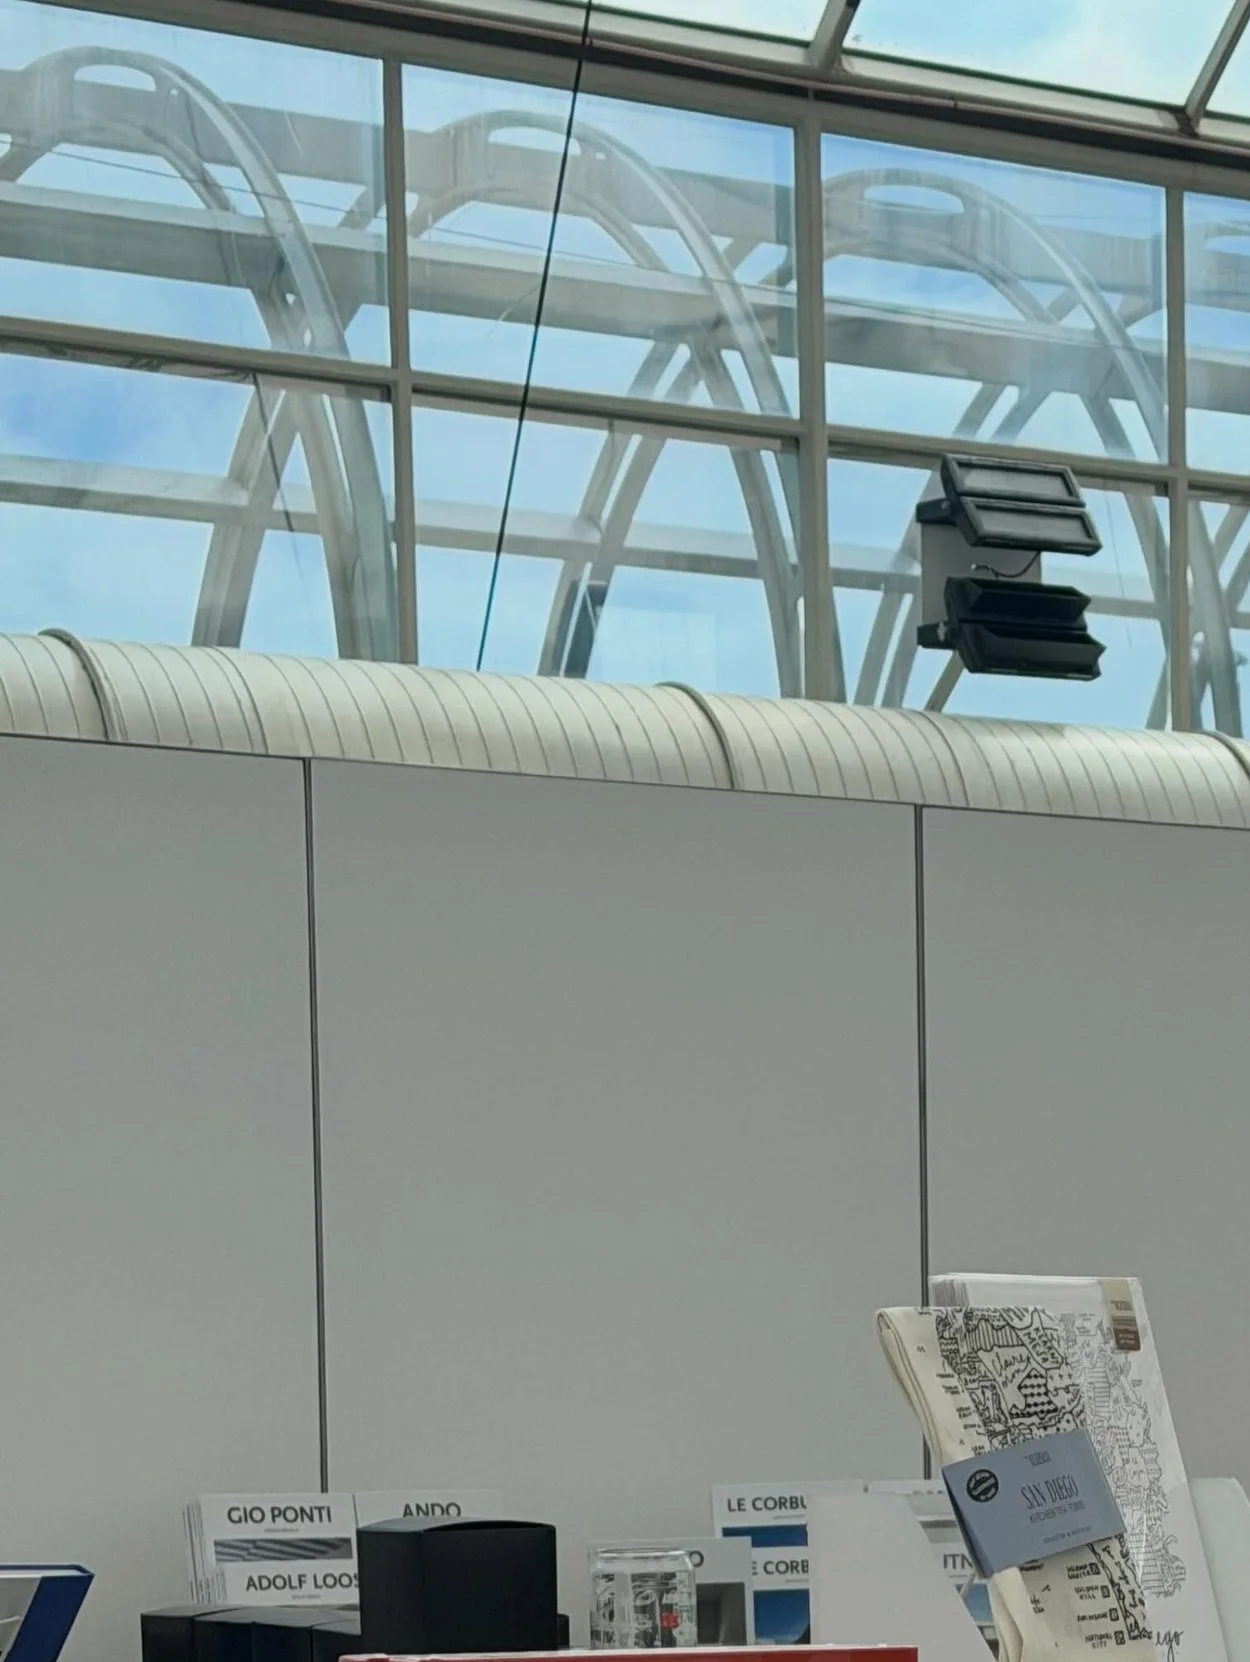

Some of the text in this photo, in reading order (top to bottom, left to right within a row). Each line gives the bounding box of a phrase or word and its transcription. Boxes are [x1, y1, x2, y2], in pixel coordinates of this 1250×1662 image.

[1020, 1481, 1048, 1510] SAN
[1050, 1474, 1080, 1504] DIEGO
[403, 1502, 462, 1517] ANDO
[727, 1497, 747, 1512] LE
[227, 1505, 333, 1524] GIO PONTI
[246, 1574, 307, 1591] ADOLF
